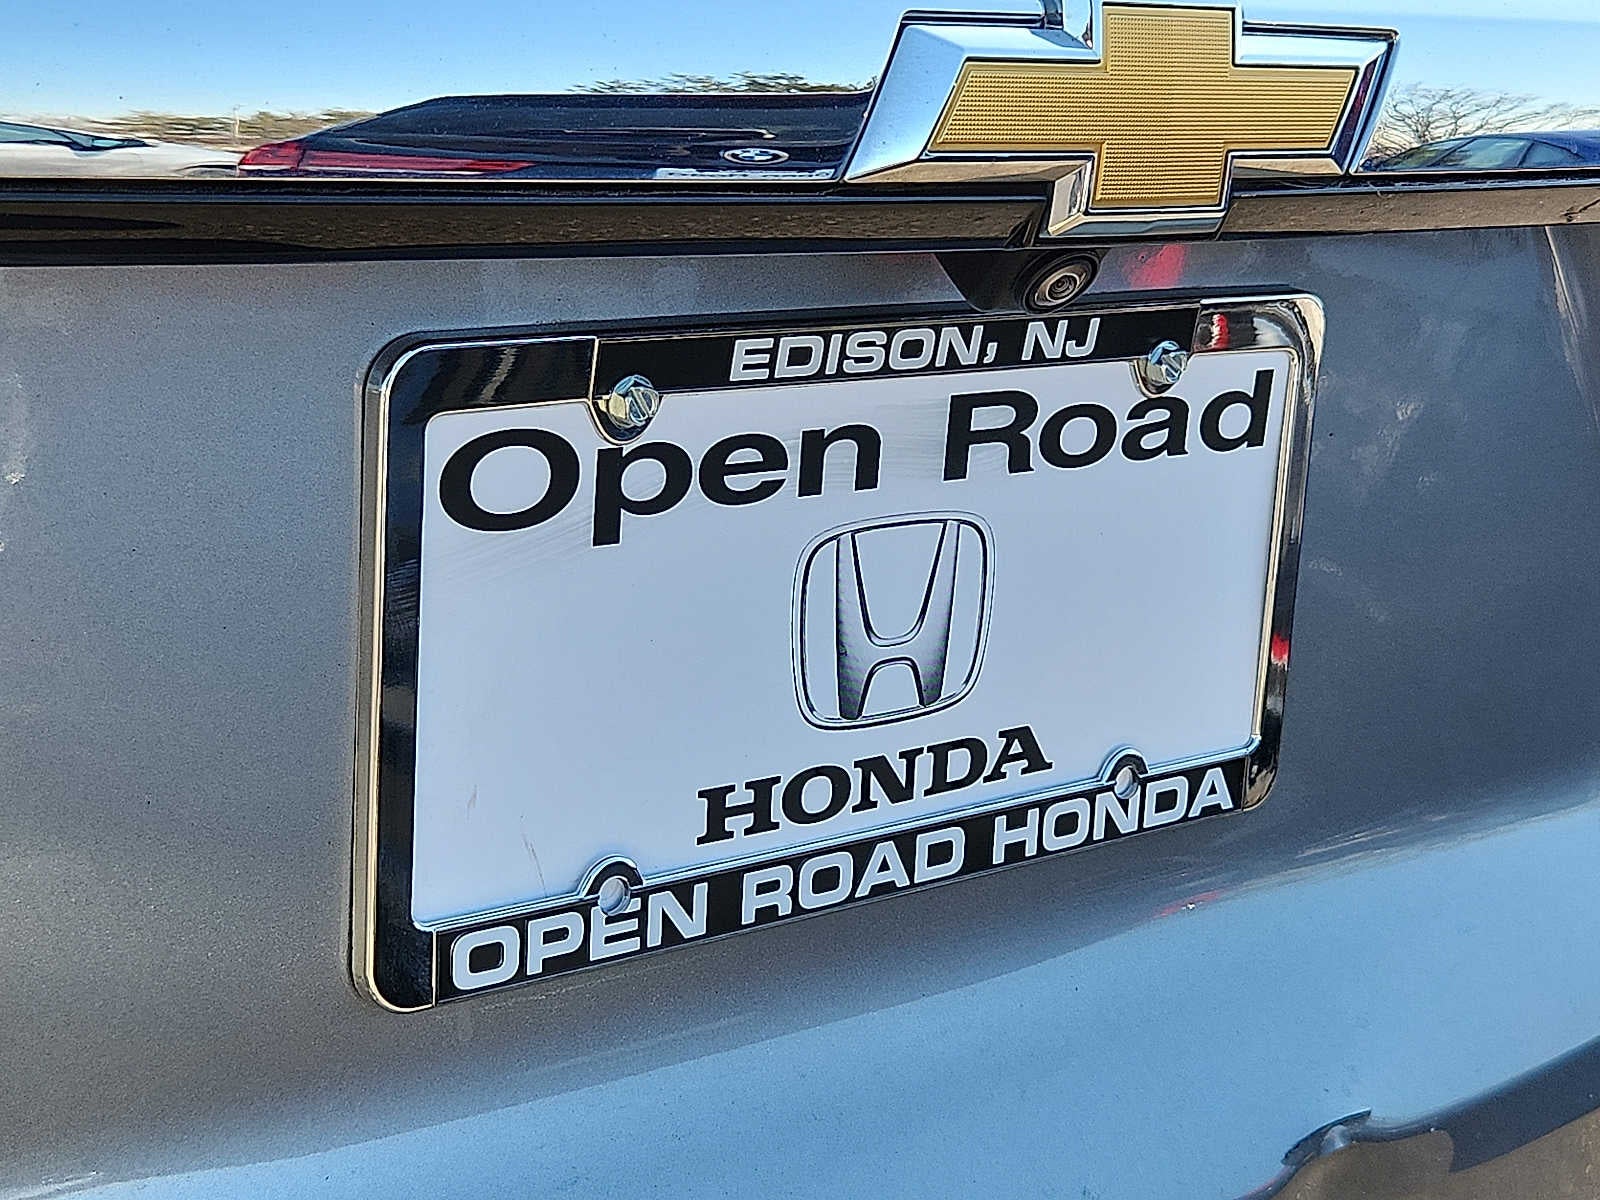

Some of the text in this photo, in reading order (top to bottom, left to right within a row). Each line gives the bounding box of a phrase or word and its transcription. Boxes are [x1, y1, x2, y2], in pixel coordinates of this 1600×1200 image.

[730, 317, 1101, 383] EDISON, NJ
[439, 369, 1274, 547] Open Road
[696, 725, 1053, 847] HONDA
[450, 766, 1235, 991] OPEN ROAD HONDA
